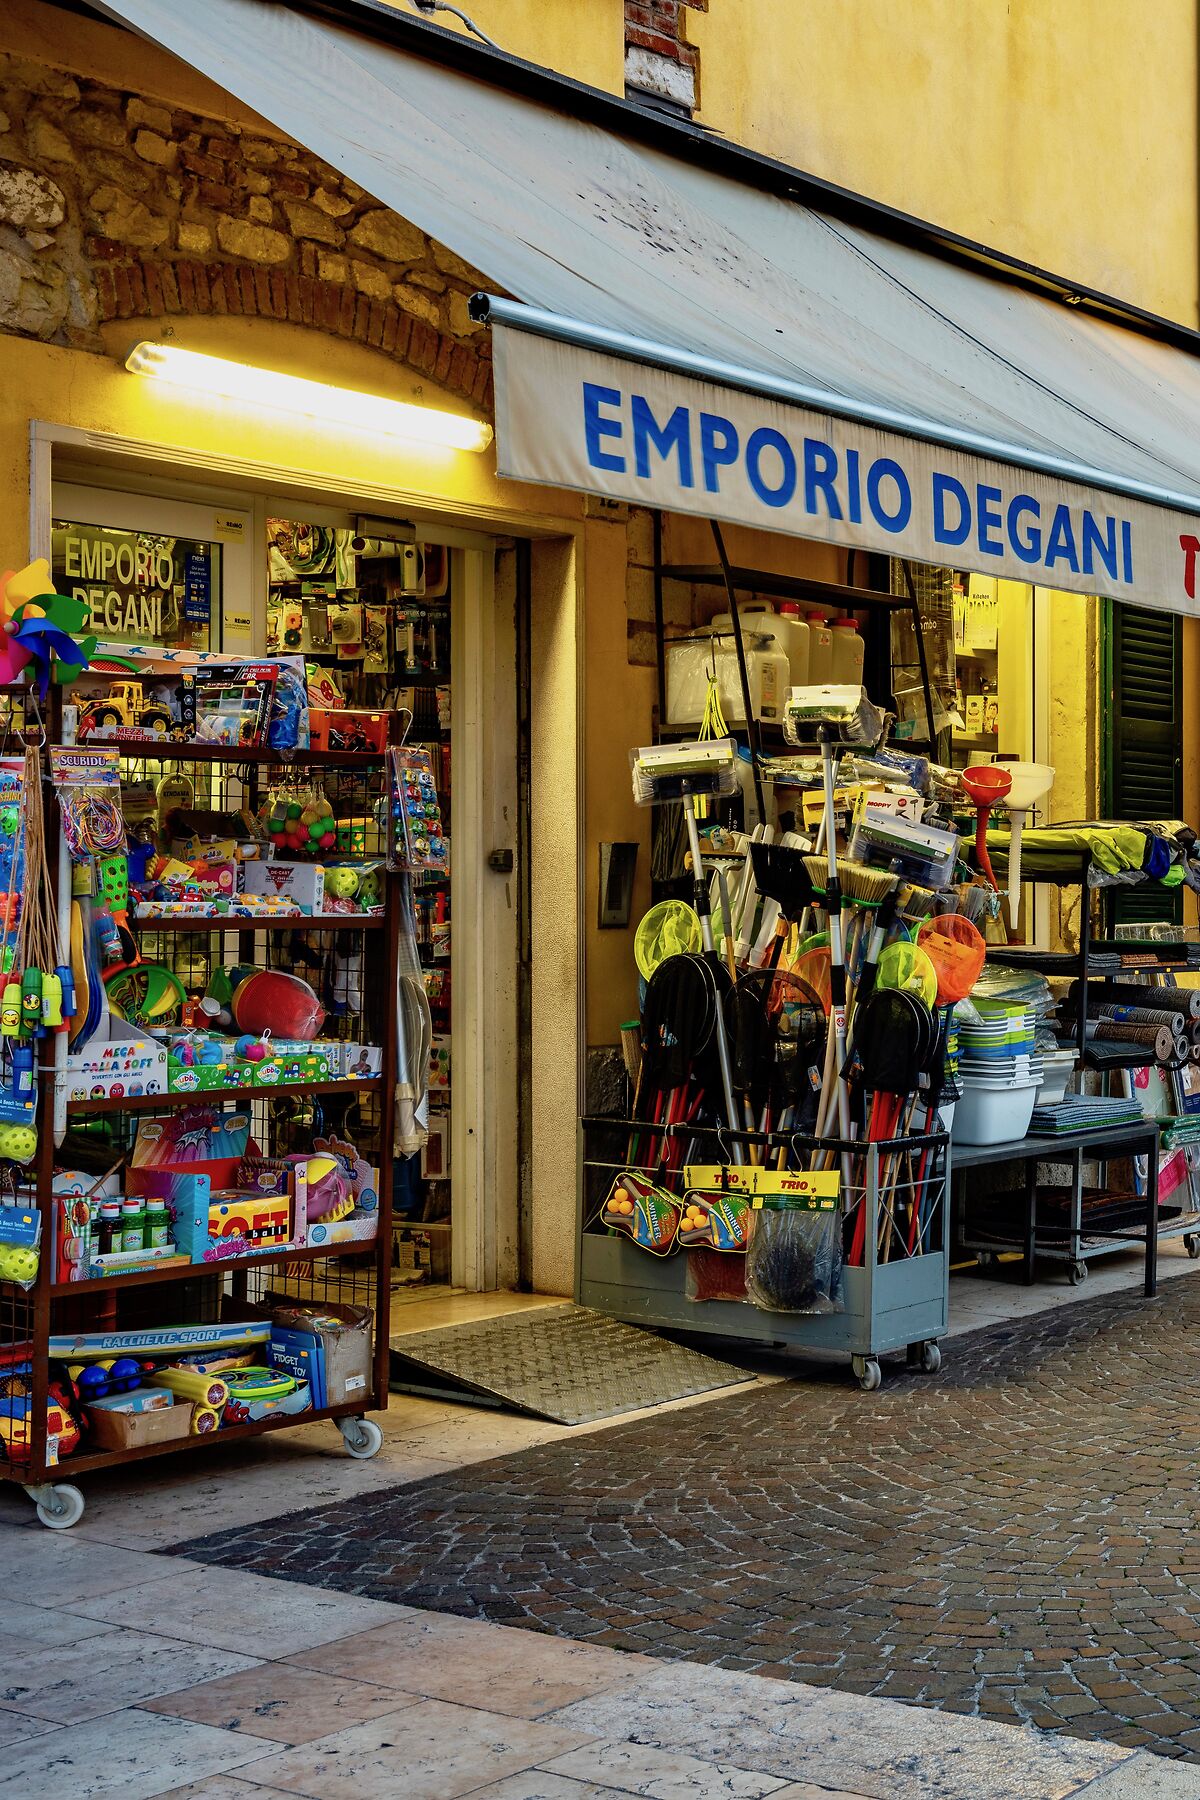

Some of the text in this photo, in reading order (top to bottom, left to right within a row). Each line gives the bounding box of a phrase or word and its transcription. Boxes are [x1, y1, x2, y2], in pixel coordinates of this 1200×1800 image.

[583, 382, 1133, 584] EMPORIO DEGANI
[65, 536, 174, 590] EMPORIO
[115, 726, 145, 735] MEZZI
[60, 755, 107, 767] SCUBIDU
[102, 1047, 136, 1059] MEGA
[124, 1058, 153, 1070] SOFT
[714, 1174, 739, 1184] TIO
[780, 1180, 809, 1190] TRIO
[649, 1201, 662, 1239] WINNER
[723, 1203, 743, 1238] WINNER
[252, 1226, 282, 1239] ball
[101, 1330, 223, 1348] RACCHETTE SPORT
[273, 1353, 299, 1366] FIDGET
[293, 1367, 307, 1377] TOY
